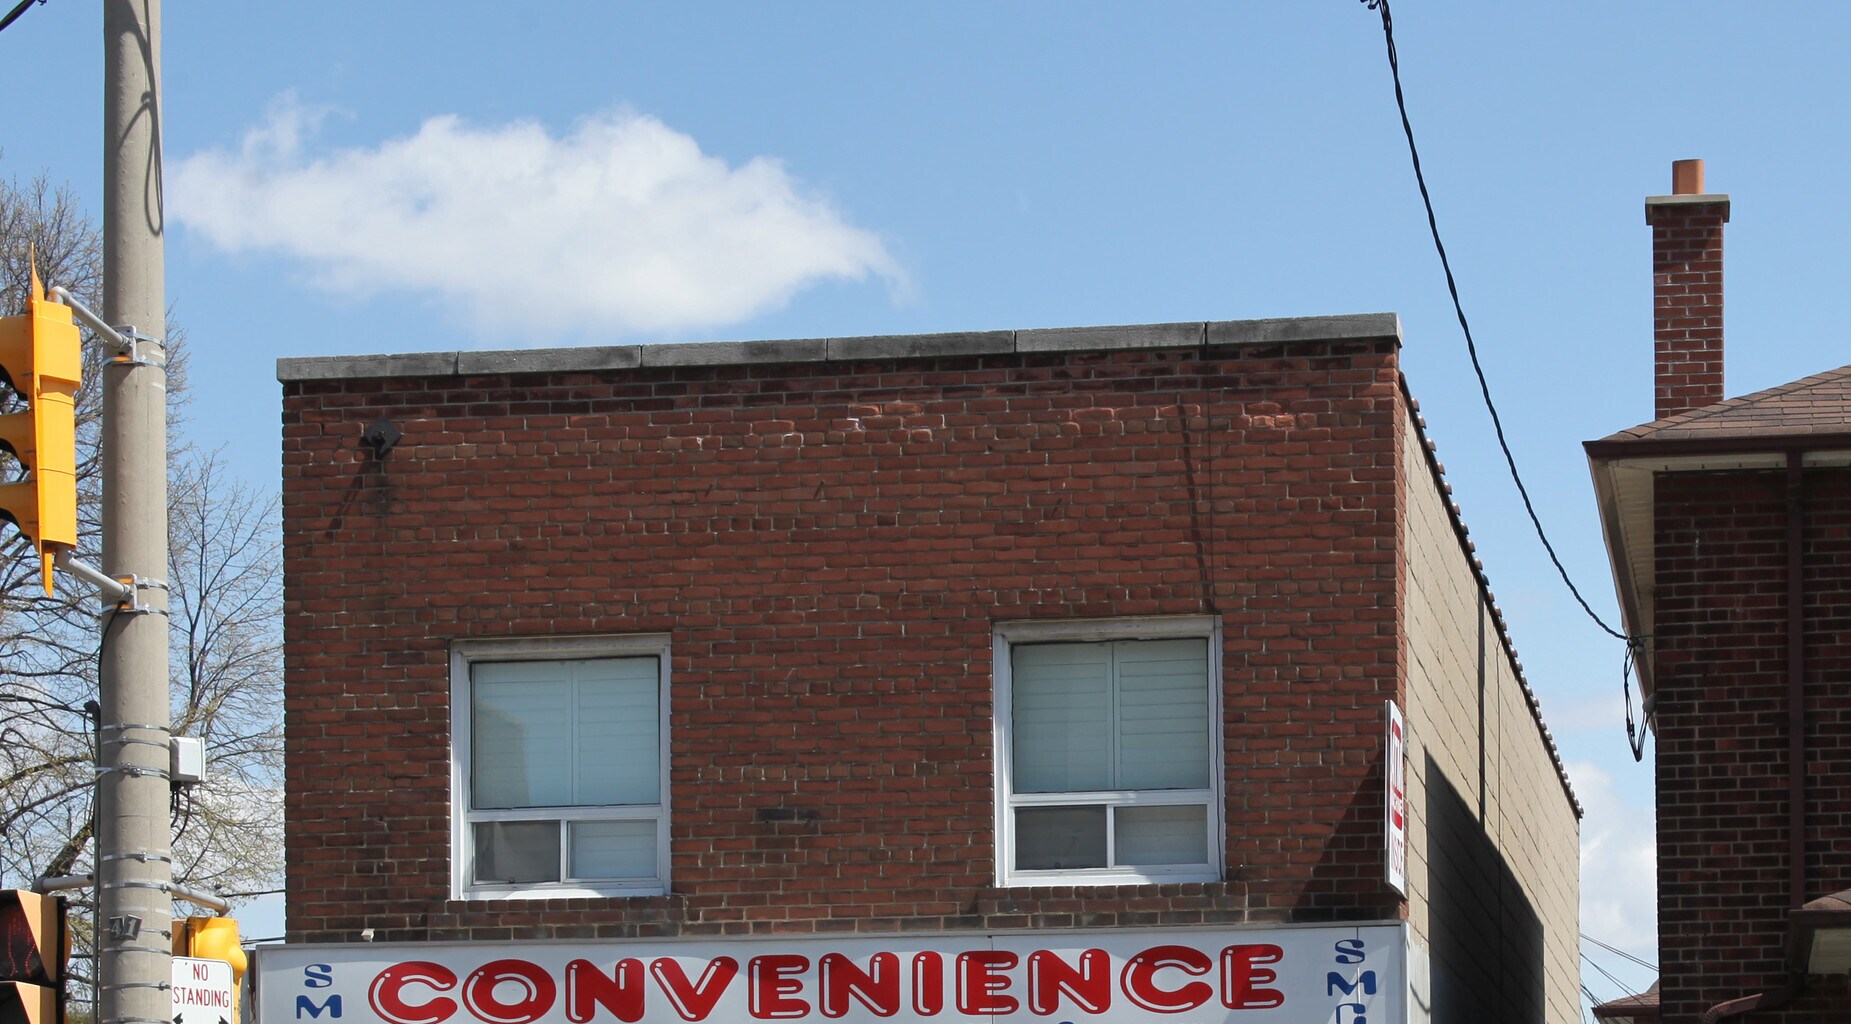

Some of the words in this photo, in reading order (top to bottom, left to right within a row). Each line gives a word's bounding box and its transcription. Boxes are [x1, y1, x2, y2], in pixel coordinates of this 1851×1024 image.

[111, 918, 136, 937] 41
[192, 963, 209, 982] NO
[173, 987, 230, 1009] STANDING
